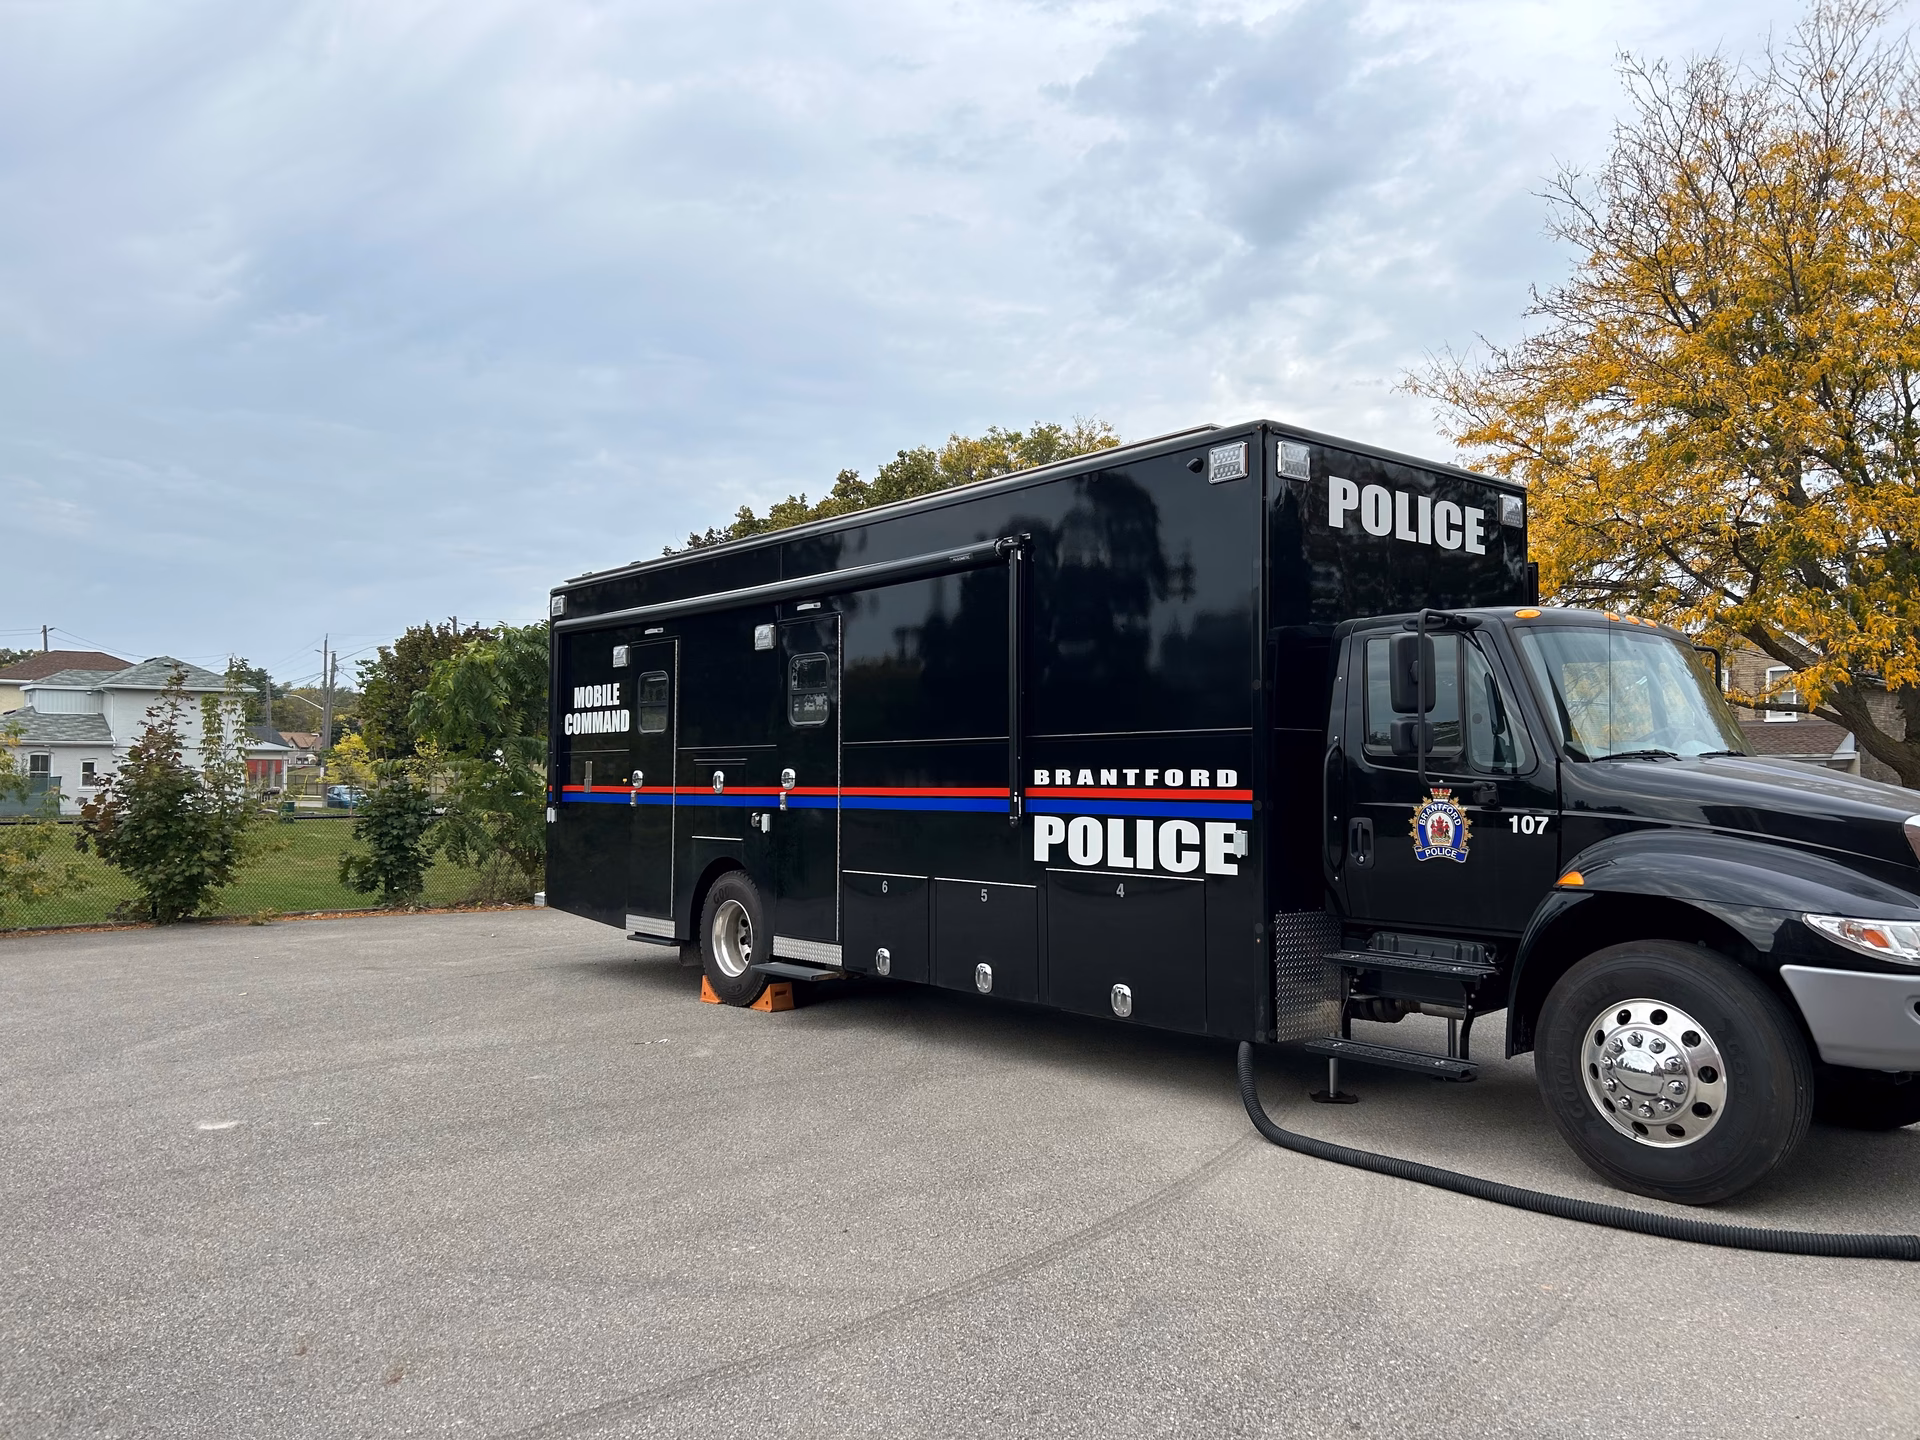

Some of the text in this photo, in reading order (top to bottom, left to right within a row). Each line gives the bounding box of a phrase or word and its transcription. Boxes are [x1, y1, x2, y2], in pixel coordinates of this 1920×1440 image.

[1328, 475, 1486, 555] POLICE
[573, 682, 620, 709] MOBILE
[564, 709, 630, 735] COMMAND
[1033, 768, 1239, 788] BRANTFORD
[1418, 803, 1462, 826] BRANTFORD
[1508, 815, 1549, 834] 107
[1033, 815, 1239, 876] POLICE
[1425, 847, 1457, 859] POLICE
[881, 880, 889, 893] 6
[980, 888, 988, 902] 5
[1116, 883, 1125, 898] 4
